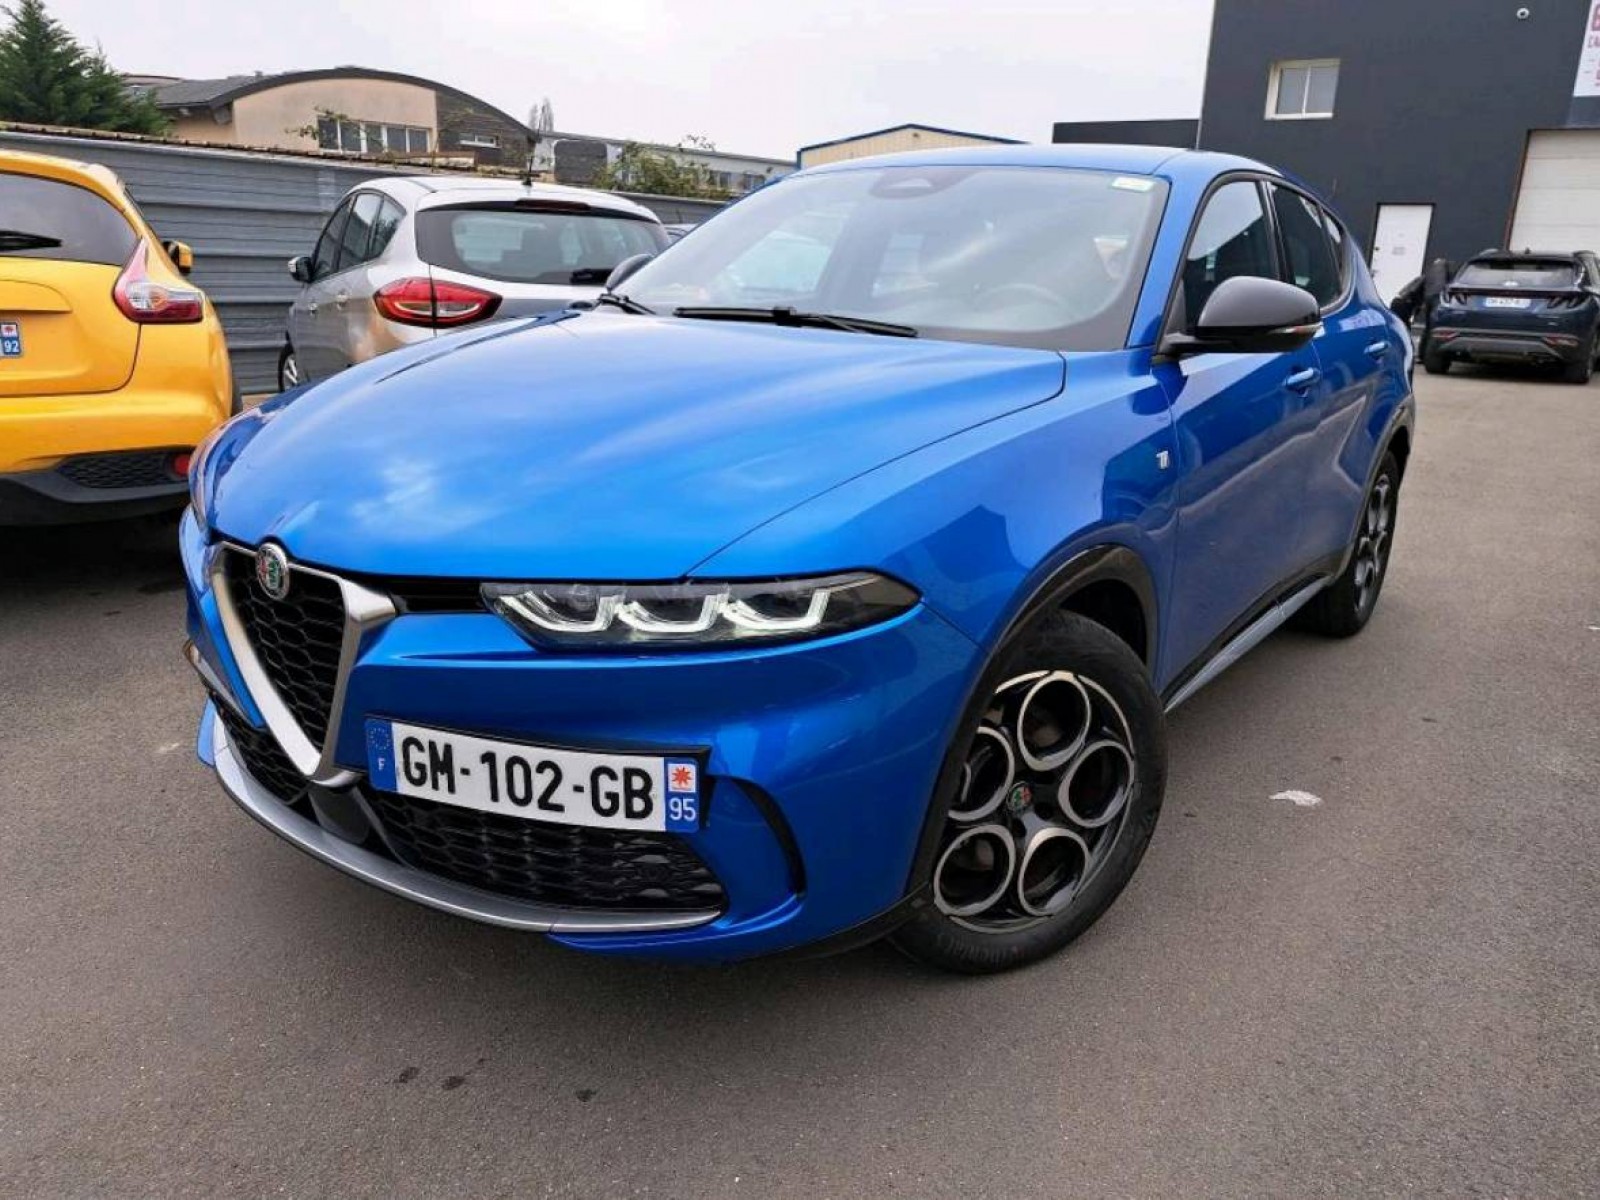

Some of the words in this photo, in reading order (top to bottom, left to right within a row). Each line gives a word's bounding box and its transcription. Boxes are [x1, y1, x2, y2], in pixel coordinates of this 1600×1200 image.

[4, 340, 19, 353] 92
[377, 758, 387, 772] F
[401, 735, 654, 820] GM-102-GB
[669, 797, 696, 821] 95
